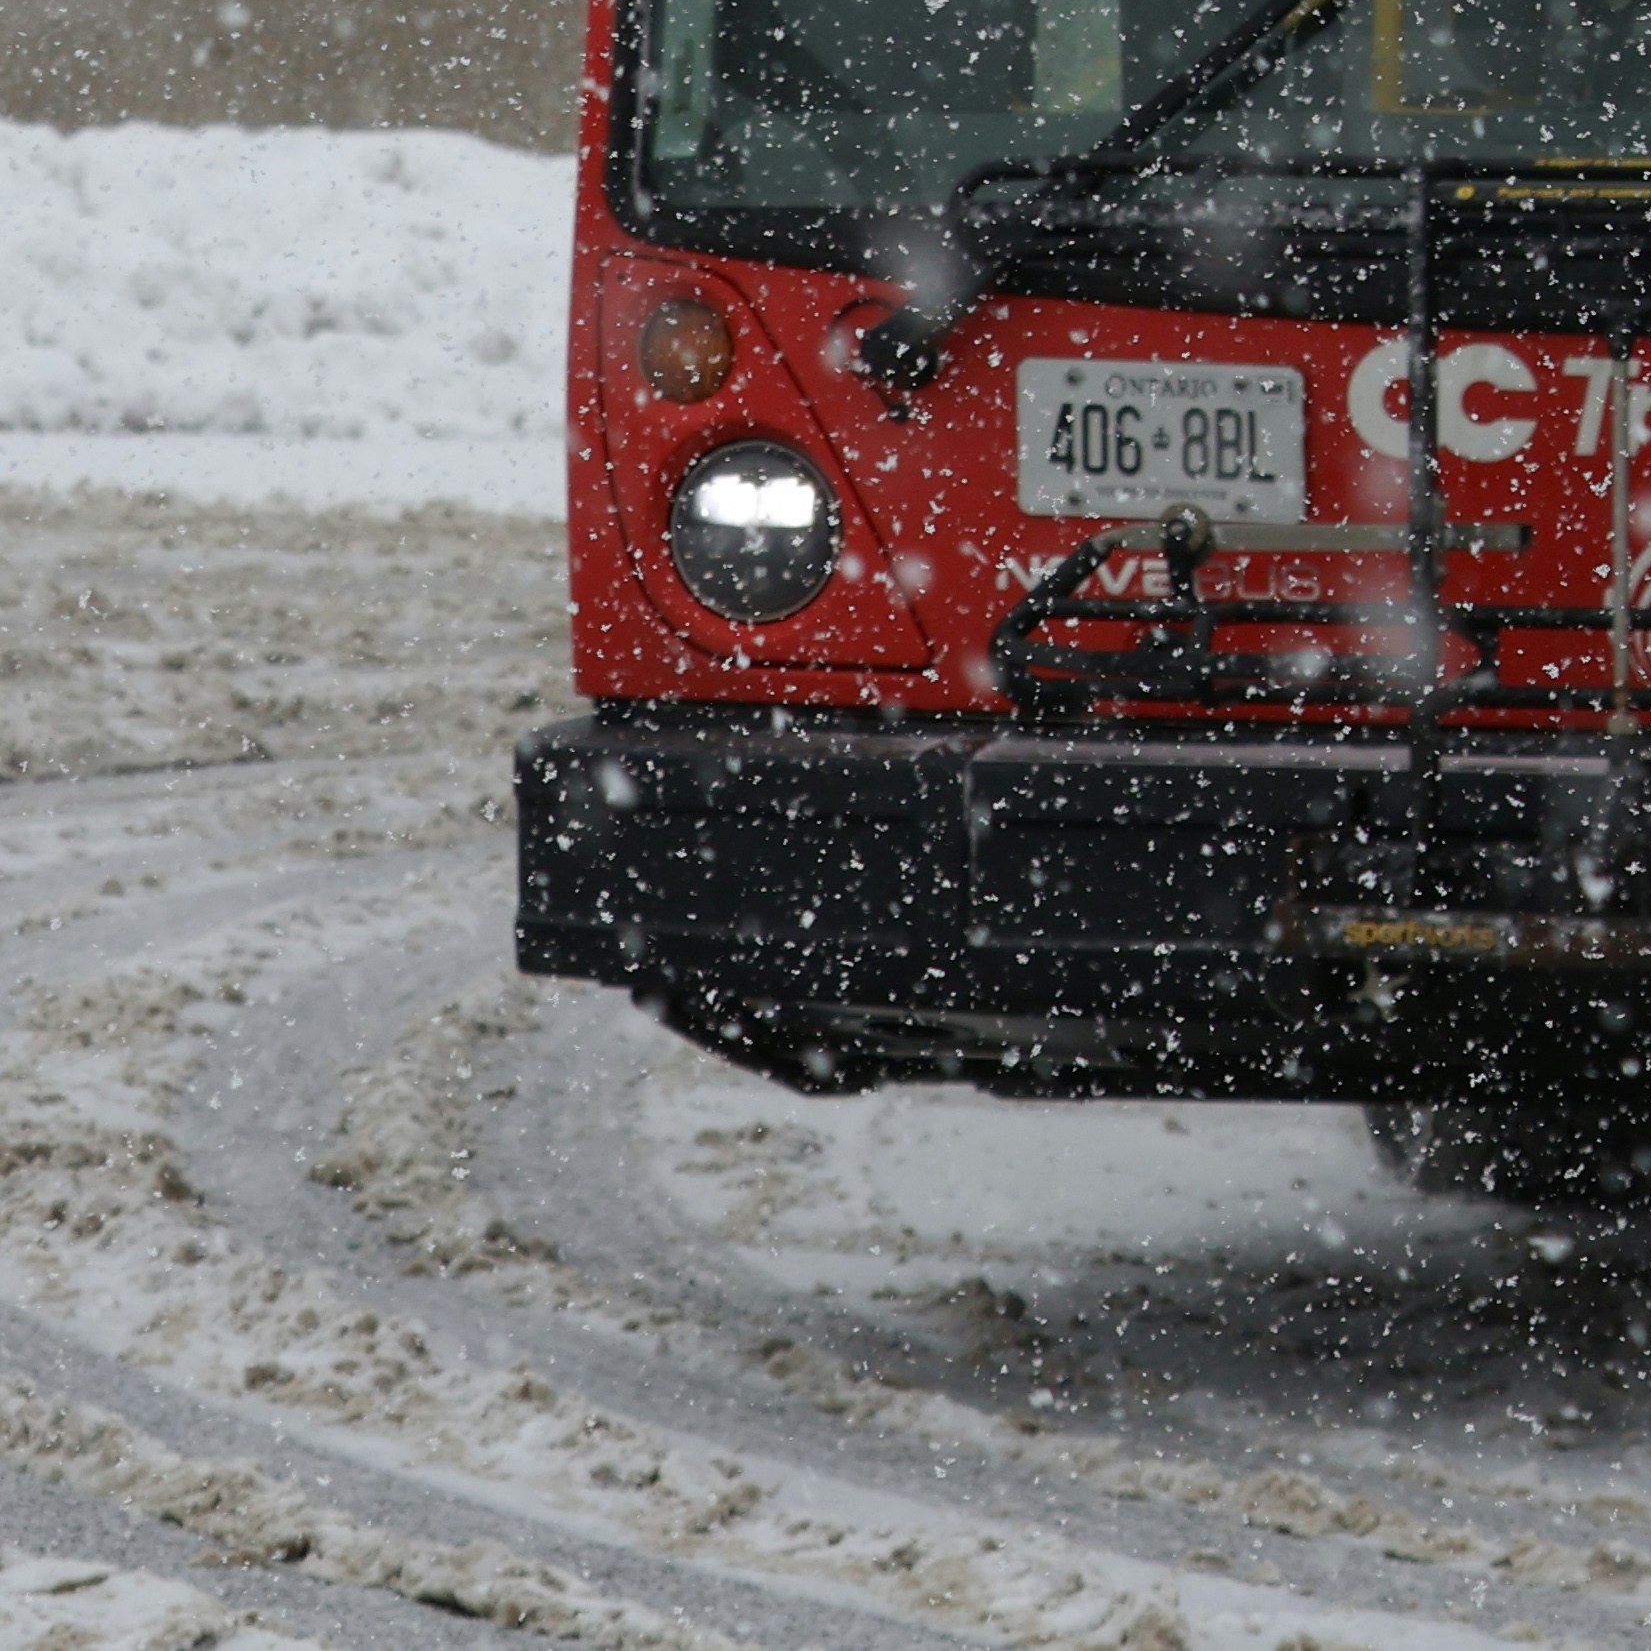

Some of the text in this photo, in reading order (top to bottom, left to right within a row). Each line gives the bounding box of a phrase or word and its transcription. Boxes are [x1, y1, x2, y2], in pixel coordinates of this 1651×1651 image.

[1050, 402, 1276, 482] 406 8BL
[1347, 338, 1538, 463] OC
